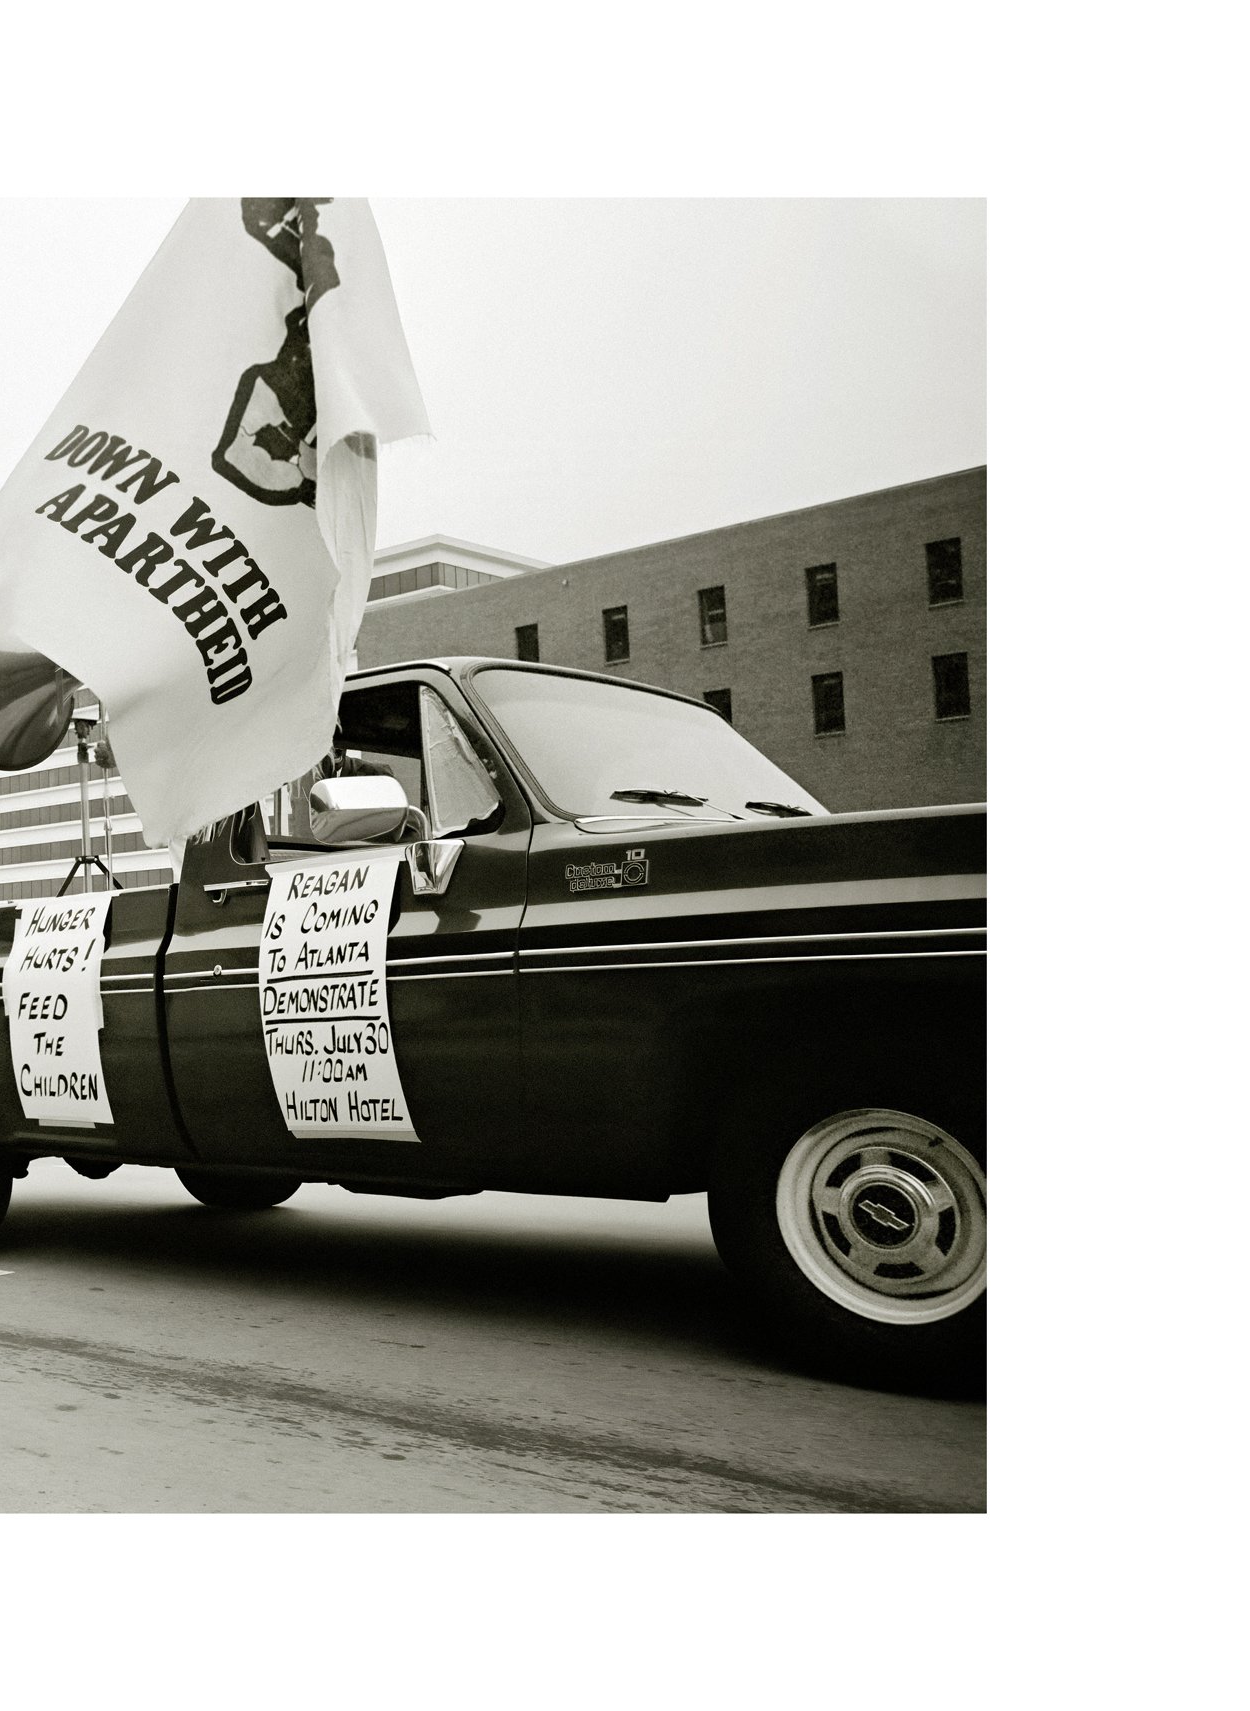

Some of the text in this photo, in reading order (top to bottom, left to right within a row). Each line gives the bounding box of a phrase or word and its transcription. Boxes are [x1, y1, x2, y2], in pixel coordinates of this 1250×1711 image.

[44, 424, 288, 640] DOWN WITH
[35, 483, 253, 705] APARTHEID
[626, 848, 646, 861] 10
[286, 865, 370, 902] REAGAN
[25, 906, 96, 938] HUNGER
[265, 899, 379, 941] IS COMING
[266, 940, 370, 974] TO ATLANTA
[17, 993, 69, 1021] FEED
[262, 978, 380, 1017] DEMONSTRATE
[33, 1033, 65, 1057] THE
[265, 1027, 320, 1057] THURS.
[20, 1063, 99, 1101] CHILDREN
[286, 1091, 404, 1123] HILTON HOTEL
